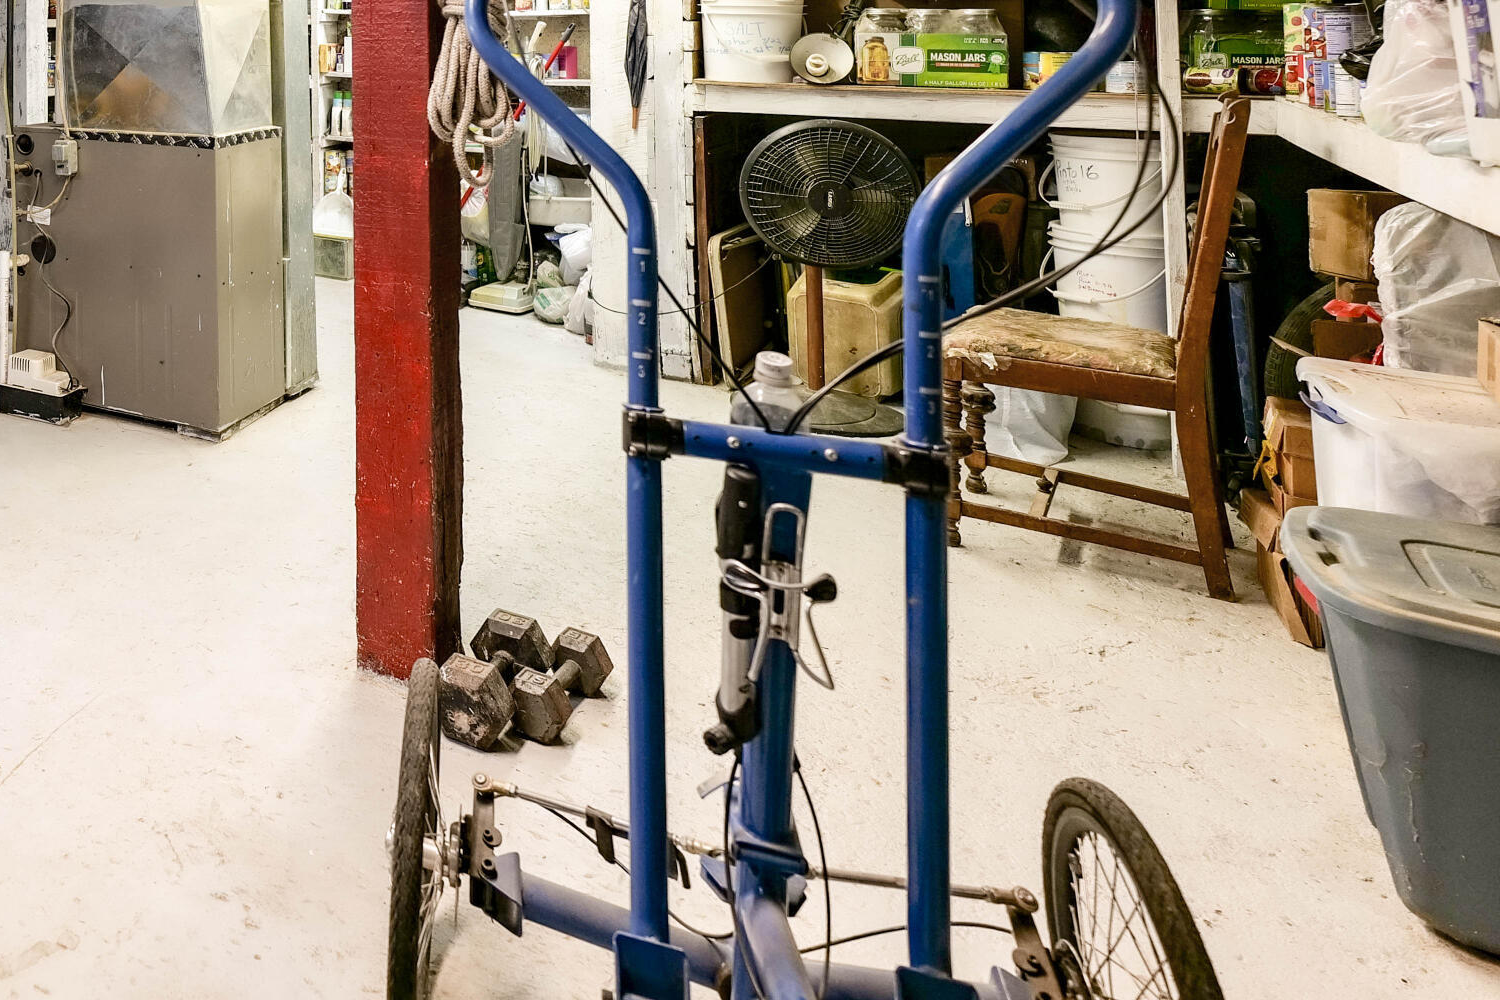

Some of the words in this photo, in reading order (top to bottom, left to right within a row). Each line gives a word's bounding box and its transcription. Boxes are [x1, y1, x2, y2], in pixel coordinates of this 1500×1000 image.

[895, 52, 921, 67] Ball
[930, 52, 961, 62] MASON
[962, 53, 987, 63] JARS
[1232, 56, 1262, 65] MASON
[1264, 57, 1286, 65] JARS
[1055, 159, 1078, 179] Pinto
[638, 260, 646, 273] 1
[637, 312, 647, 325] 2
[926, 345, 935, 359] 2
[637, 364, 646, 378] 3
[927, 400, 937, 415] 3
